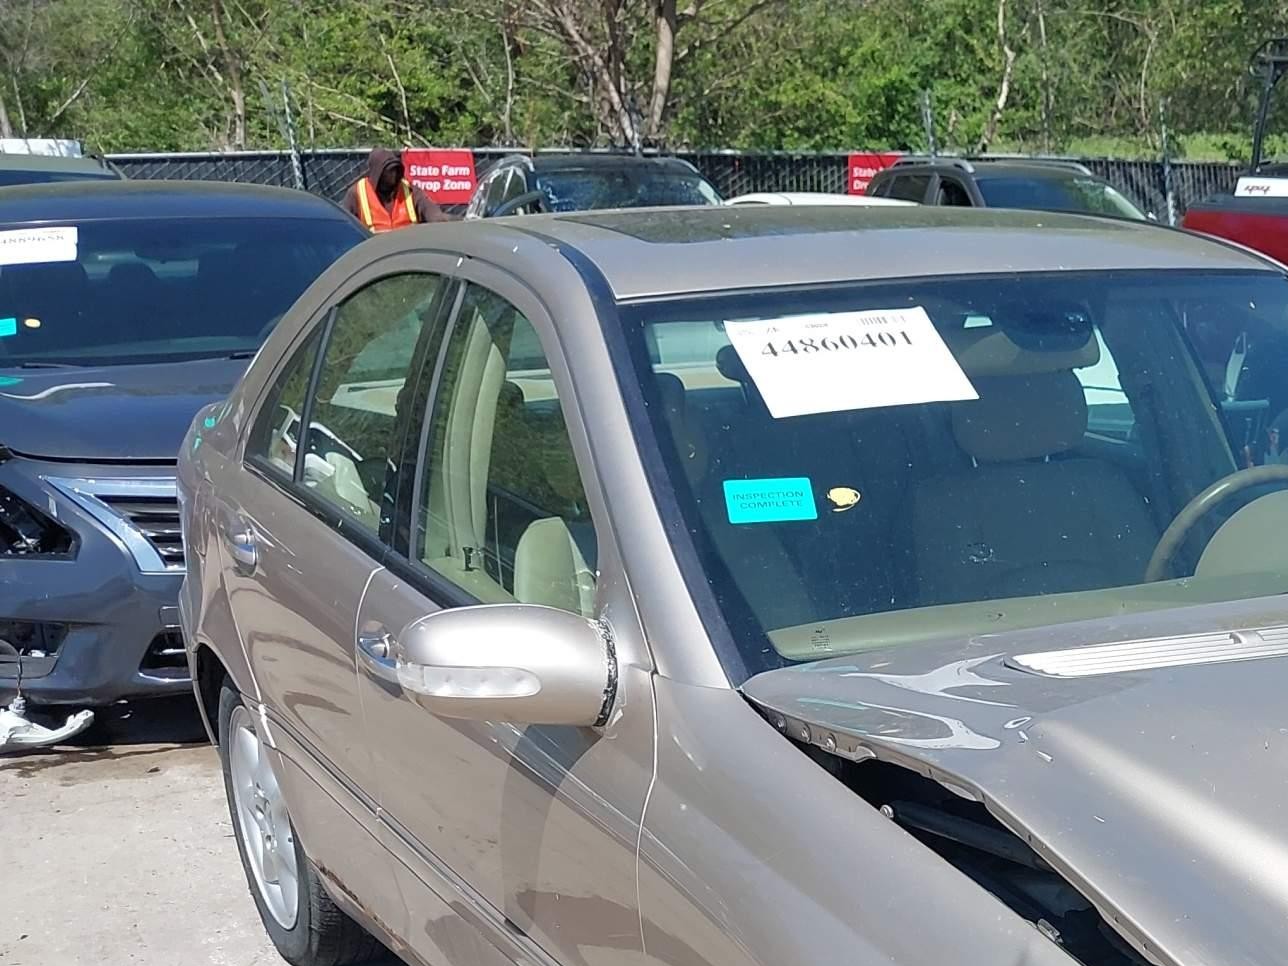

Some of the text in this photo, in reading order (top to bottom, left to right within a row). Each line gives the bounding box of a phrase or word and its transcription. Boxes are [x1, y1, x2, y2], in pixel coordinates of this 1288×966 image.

[409, 164, 471, 177] State Farm
[443, 178, 472, 191] Zone
[761, 330, 913, 358] 44860401
[732, 490, 804, 501] INSPECTION
[740, 499, 803, 510] COMPLETE
